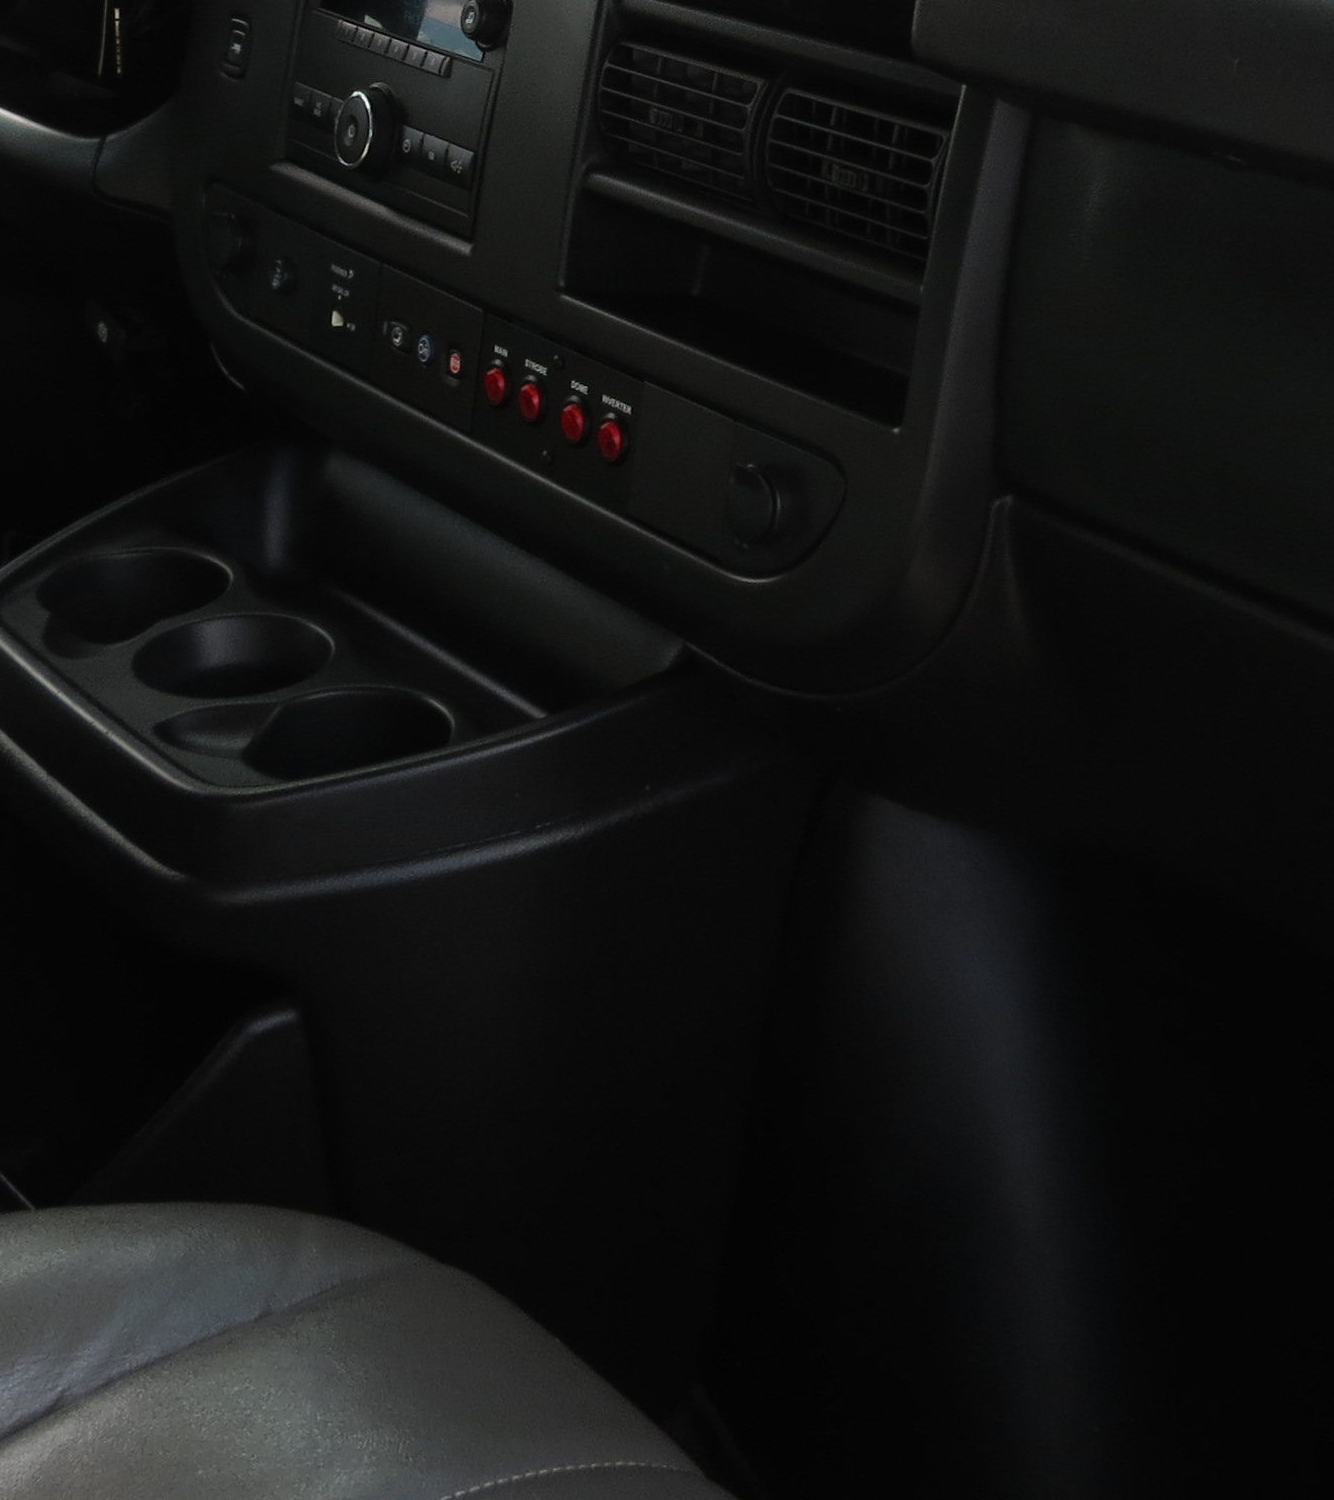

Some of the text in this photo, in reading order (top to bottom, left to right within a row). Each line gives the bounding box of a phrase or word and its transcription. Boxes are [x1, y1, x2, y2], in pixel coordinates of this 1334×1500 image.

[494, 344, 508, 357] MAIN
[524, 358, 548, 376] STROBE
[570, 380, 589, 395] DOME
[601, 394, 632, 415] INVERTER
